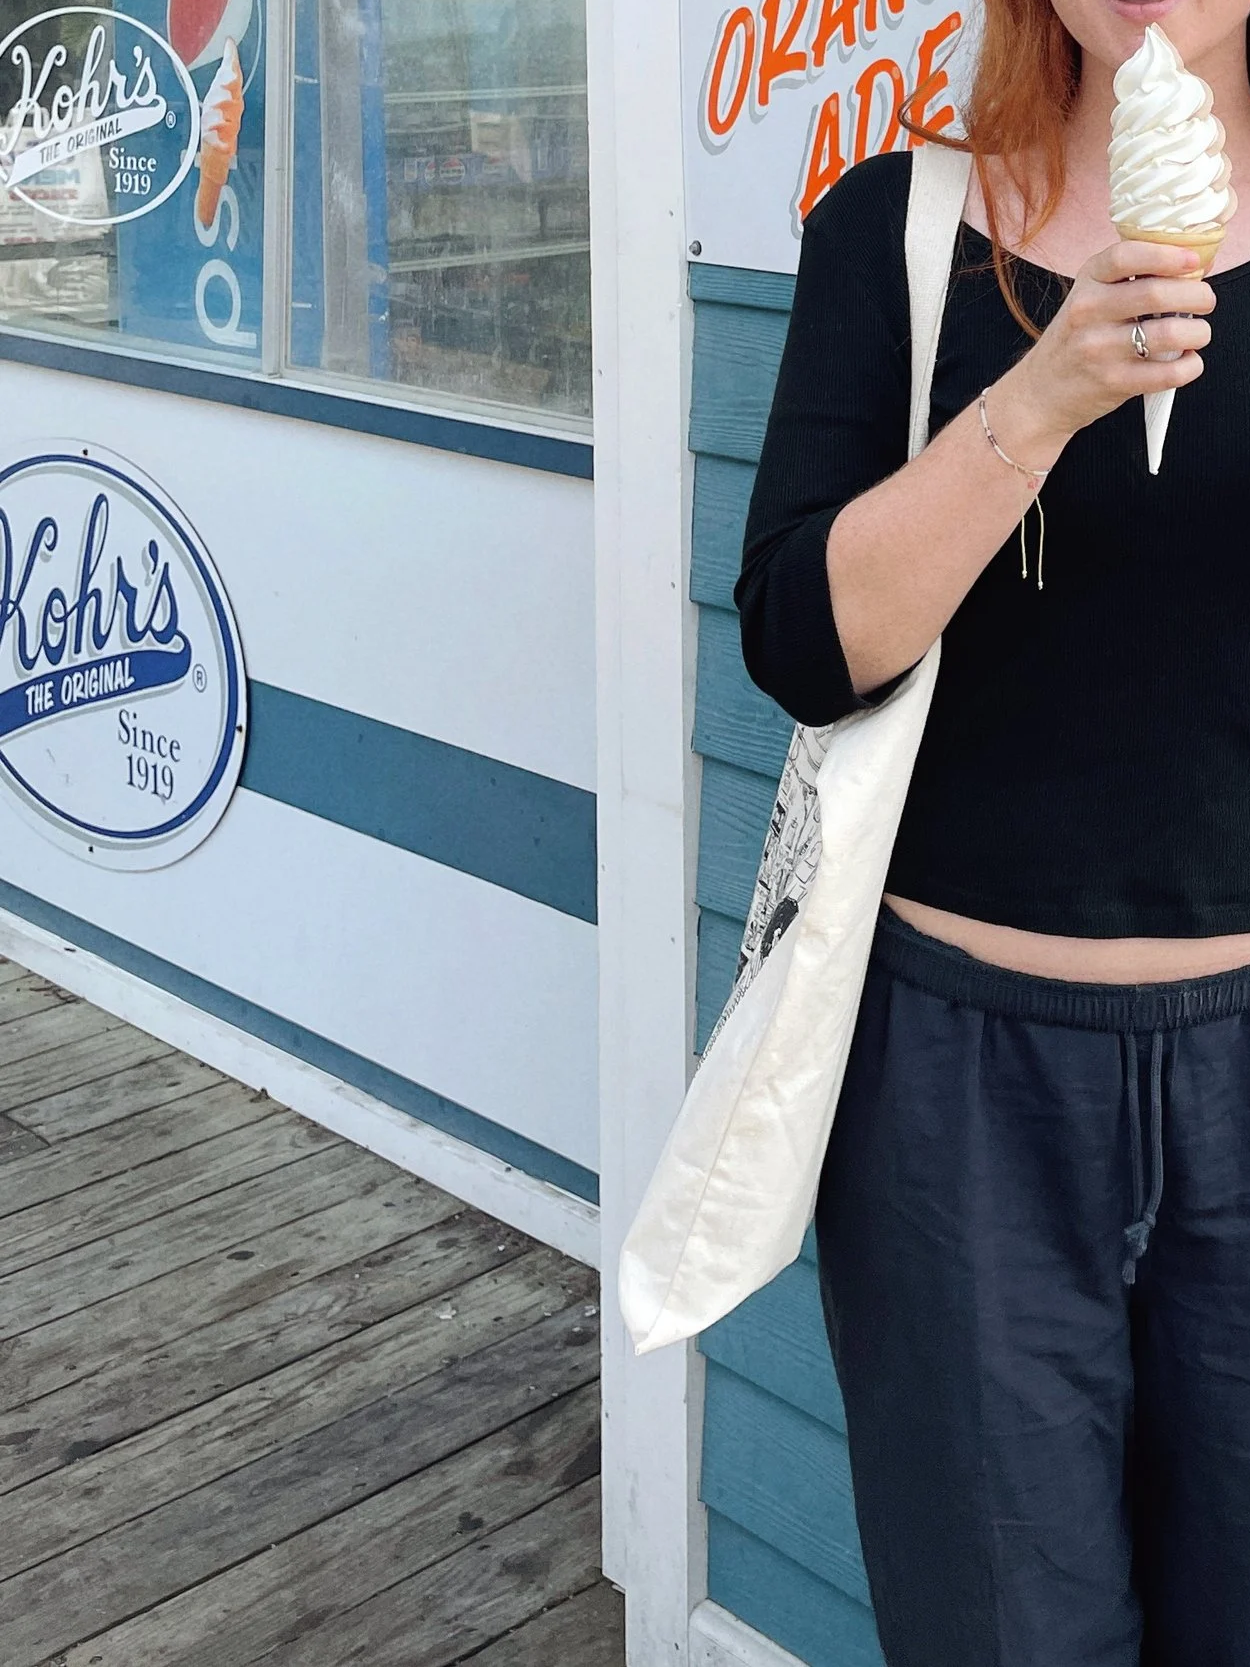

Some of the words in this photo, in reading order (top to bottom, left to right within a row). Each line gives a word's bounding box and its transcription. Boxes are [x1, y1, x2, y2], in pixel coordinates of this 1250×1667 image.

[0, 24, 162, 155] Kohr's
[800, 11, 963, 224] ADE
[39, 142, 61, 166] THE
[67, 116, 123, 154] ORIGINAL
[108, 146, 157, 174] Since
[113, 172, 152, 195] 1919
[0, 492, 188, 671] Kohr's
[25, 681, 55, 716] THE
[60, 656, 136, 707] ORIGINAL
[117, 708, 182, 764] Since
[126, 752, 175, 801] 1919
